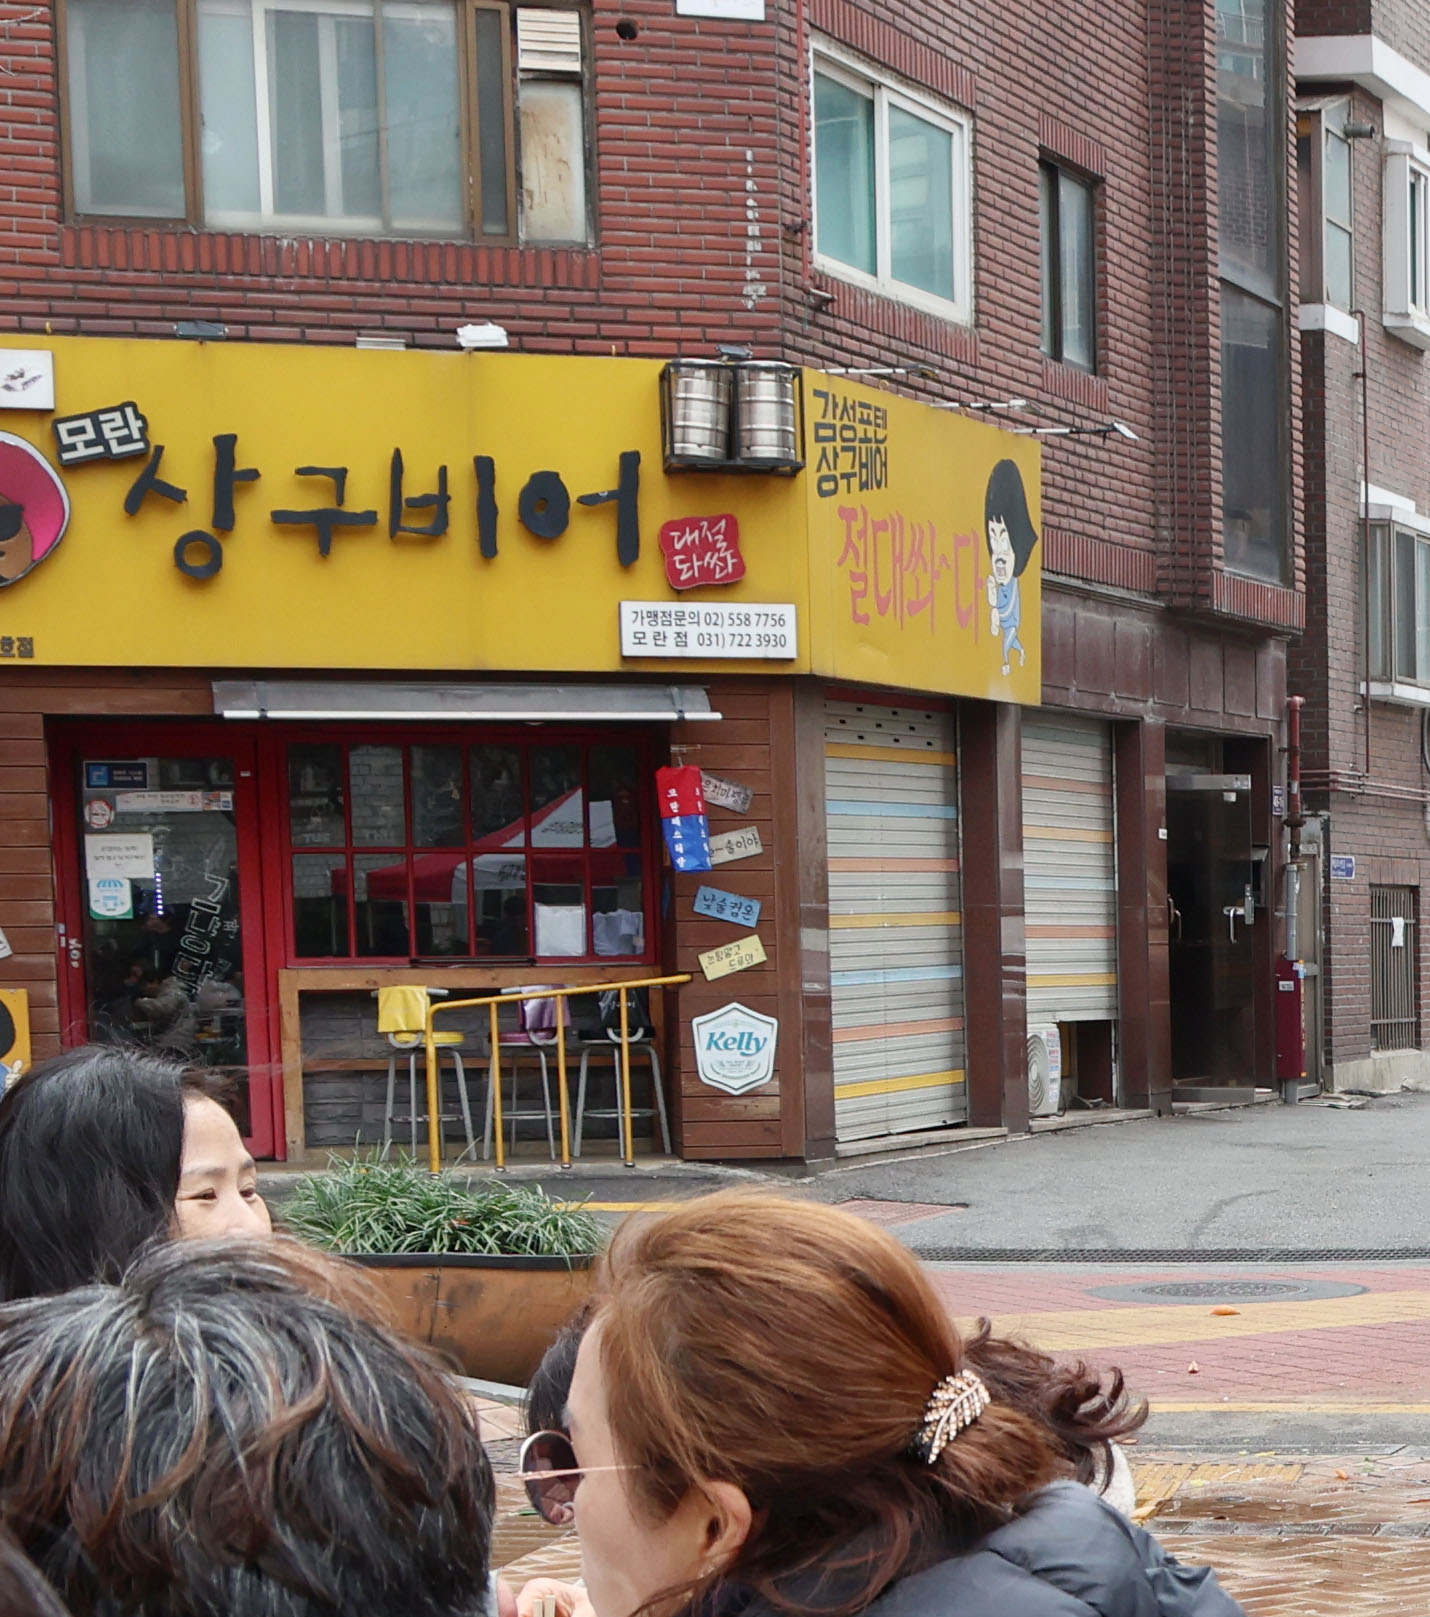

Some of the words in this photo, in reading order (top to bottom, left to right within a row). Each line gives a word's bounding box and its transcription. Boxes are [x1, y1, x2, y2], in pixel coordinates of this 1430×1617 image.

[56, 406, 147, 463] 모란
[813, 388, 888, 444] 감성포텐
[816, 445, 888, 498] 상구비어
[124, 433, 641, 580] 상구비어
[632, 610, 700, 627] 가맹점문의
[704, 611, 725, 628] 02)
[728, 612, 751, 627] 558
[755, 613, 786, 628] 7756
[697, 633, 725, 648] 031)
[729, 634, 752, 648] 722
[756, 634, 787, 648] 3930
[706, 1032, 768, 1057] Kelly
